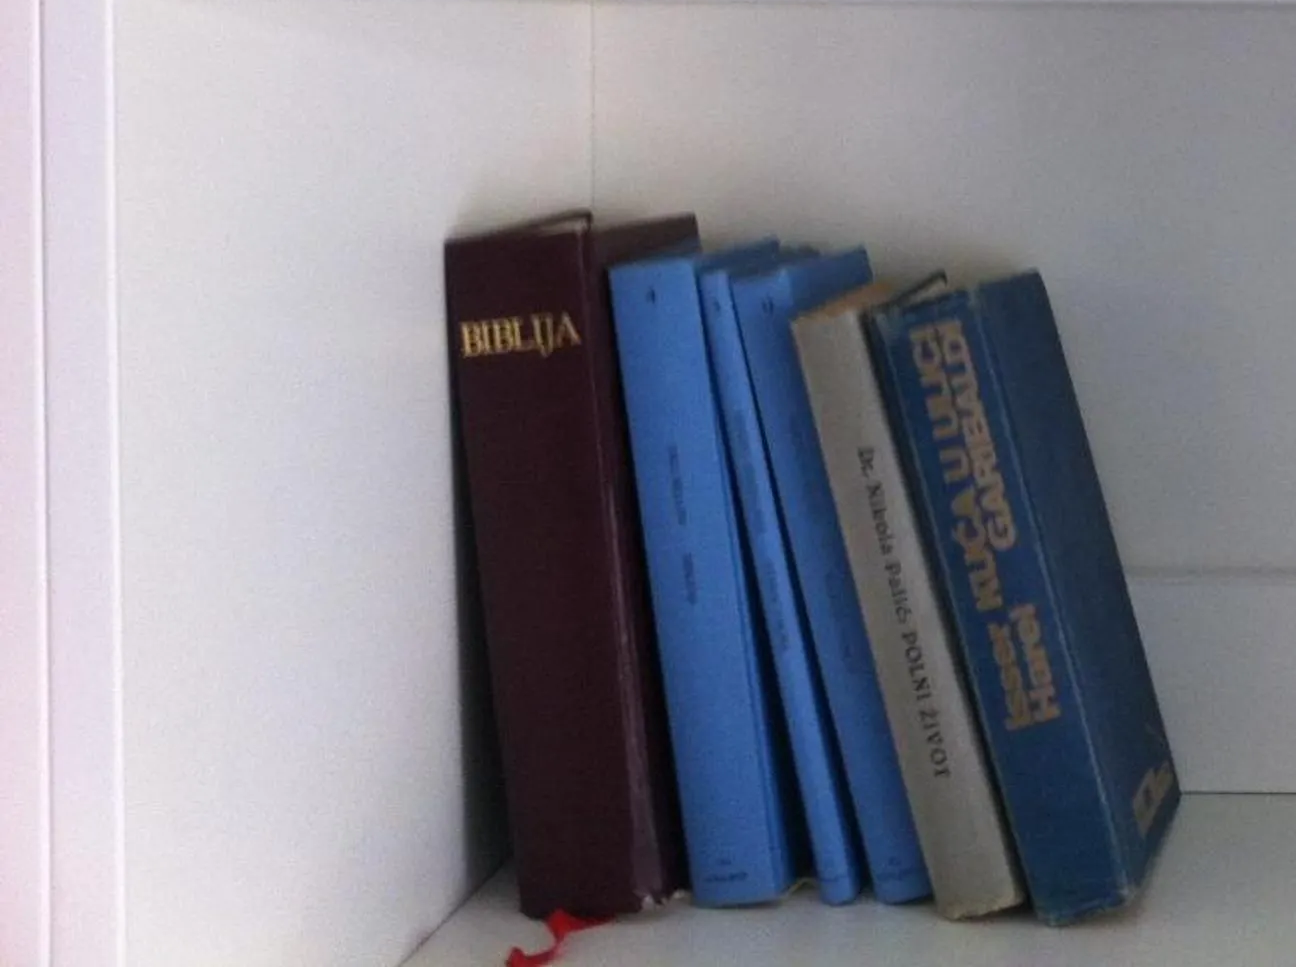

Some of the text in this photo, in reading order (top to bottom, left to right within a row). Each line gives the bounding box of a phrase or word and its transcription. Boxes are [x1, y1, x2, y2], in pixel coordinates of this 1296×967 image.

[459, 311, 581, 359] BIBLIJA
[909, 327, 1004, 612] KUĆA U ULICI
[933, 319, 1017, 552] GARIBALDI
[902, 631, 931, 701] POLNI
[1009, 604, 1061, 721] Harel
